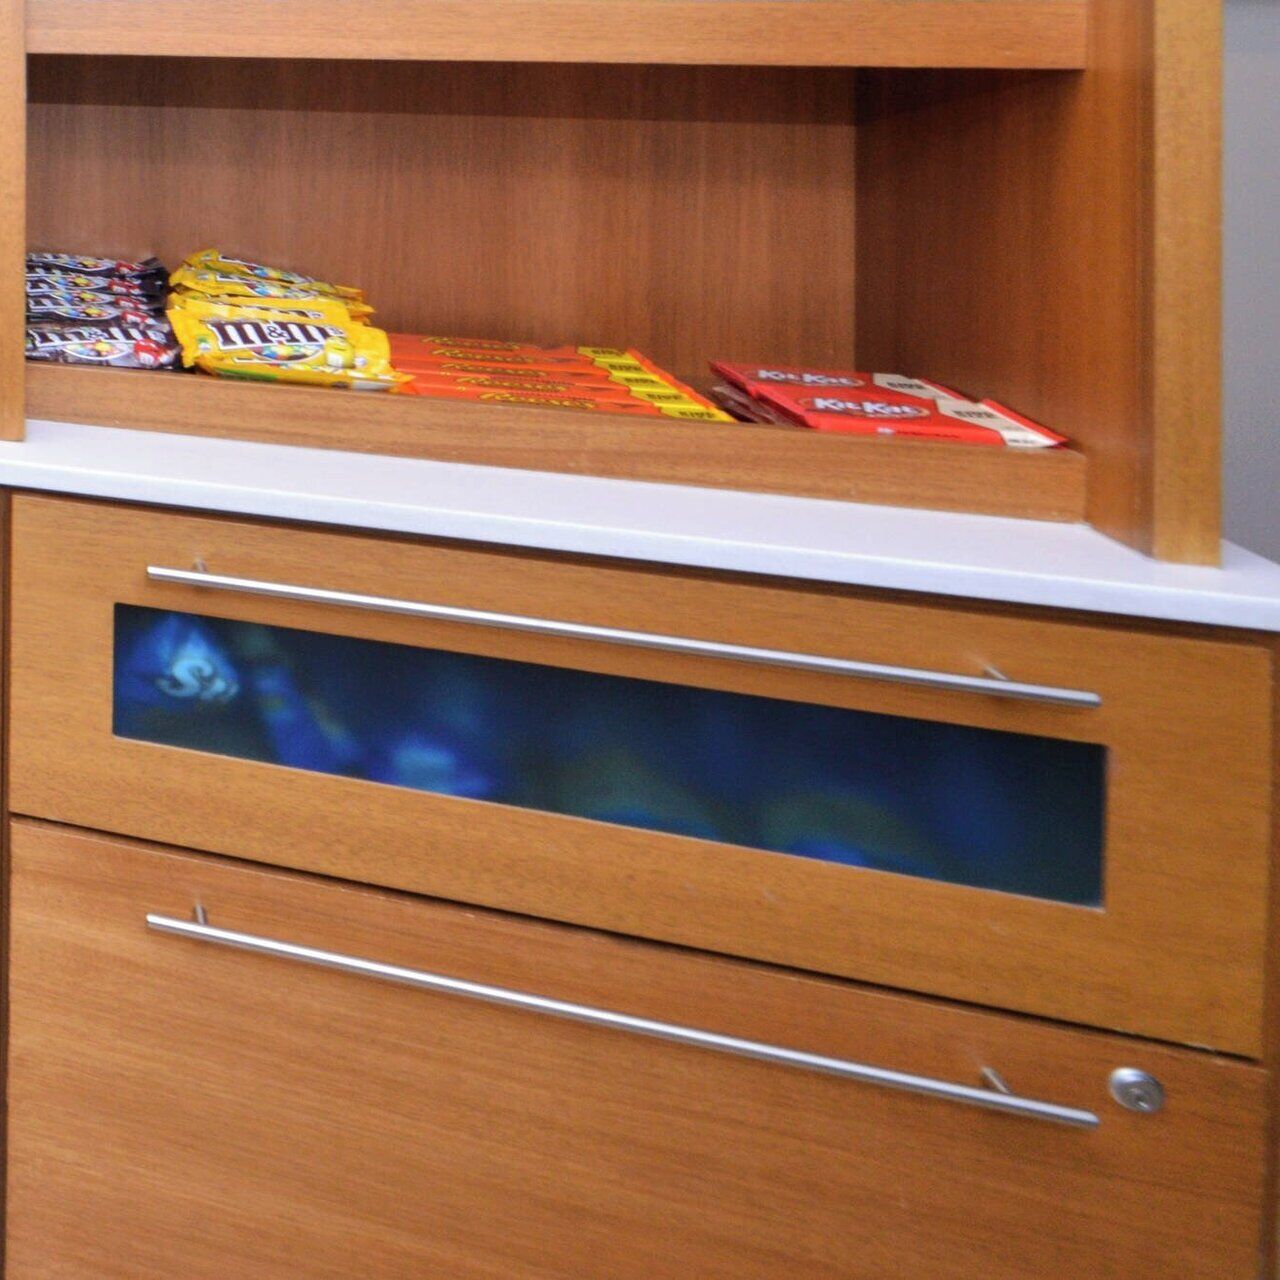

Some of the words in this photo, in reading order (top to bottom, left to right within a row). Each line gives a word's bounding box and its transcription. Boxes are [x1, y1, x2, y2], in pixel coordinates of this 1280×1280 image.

[757, 370, 789, 382] Kit
[800, 372, 858, 386] Kat
[813, 398, 859, 413] Kit
[861, 401, 920, 417] Kat
